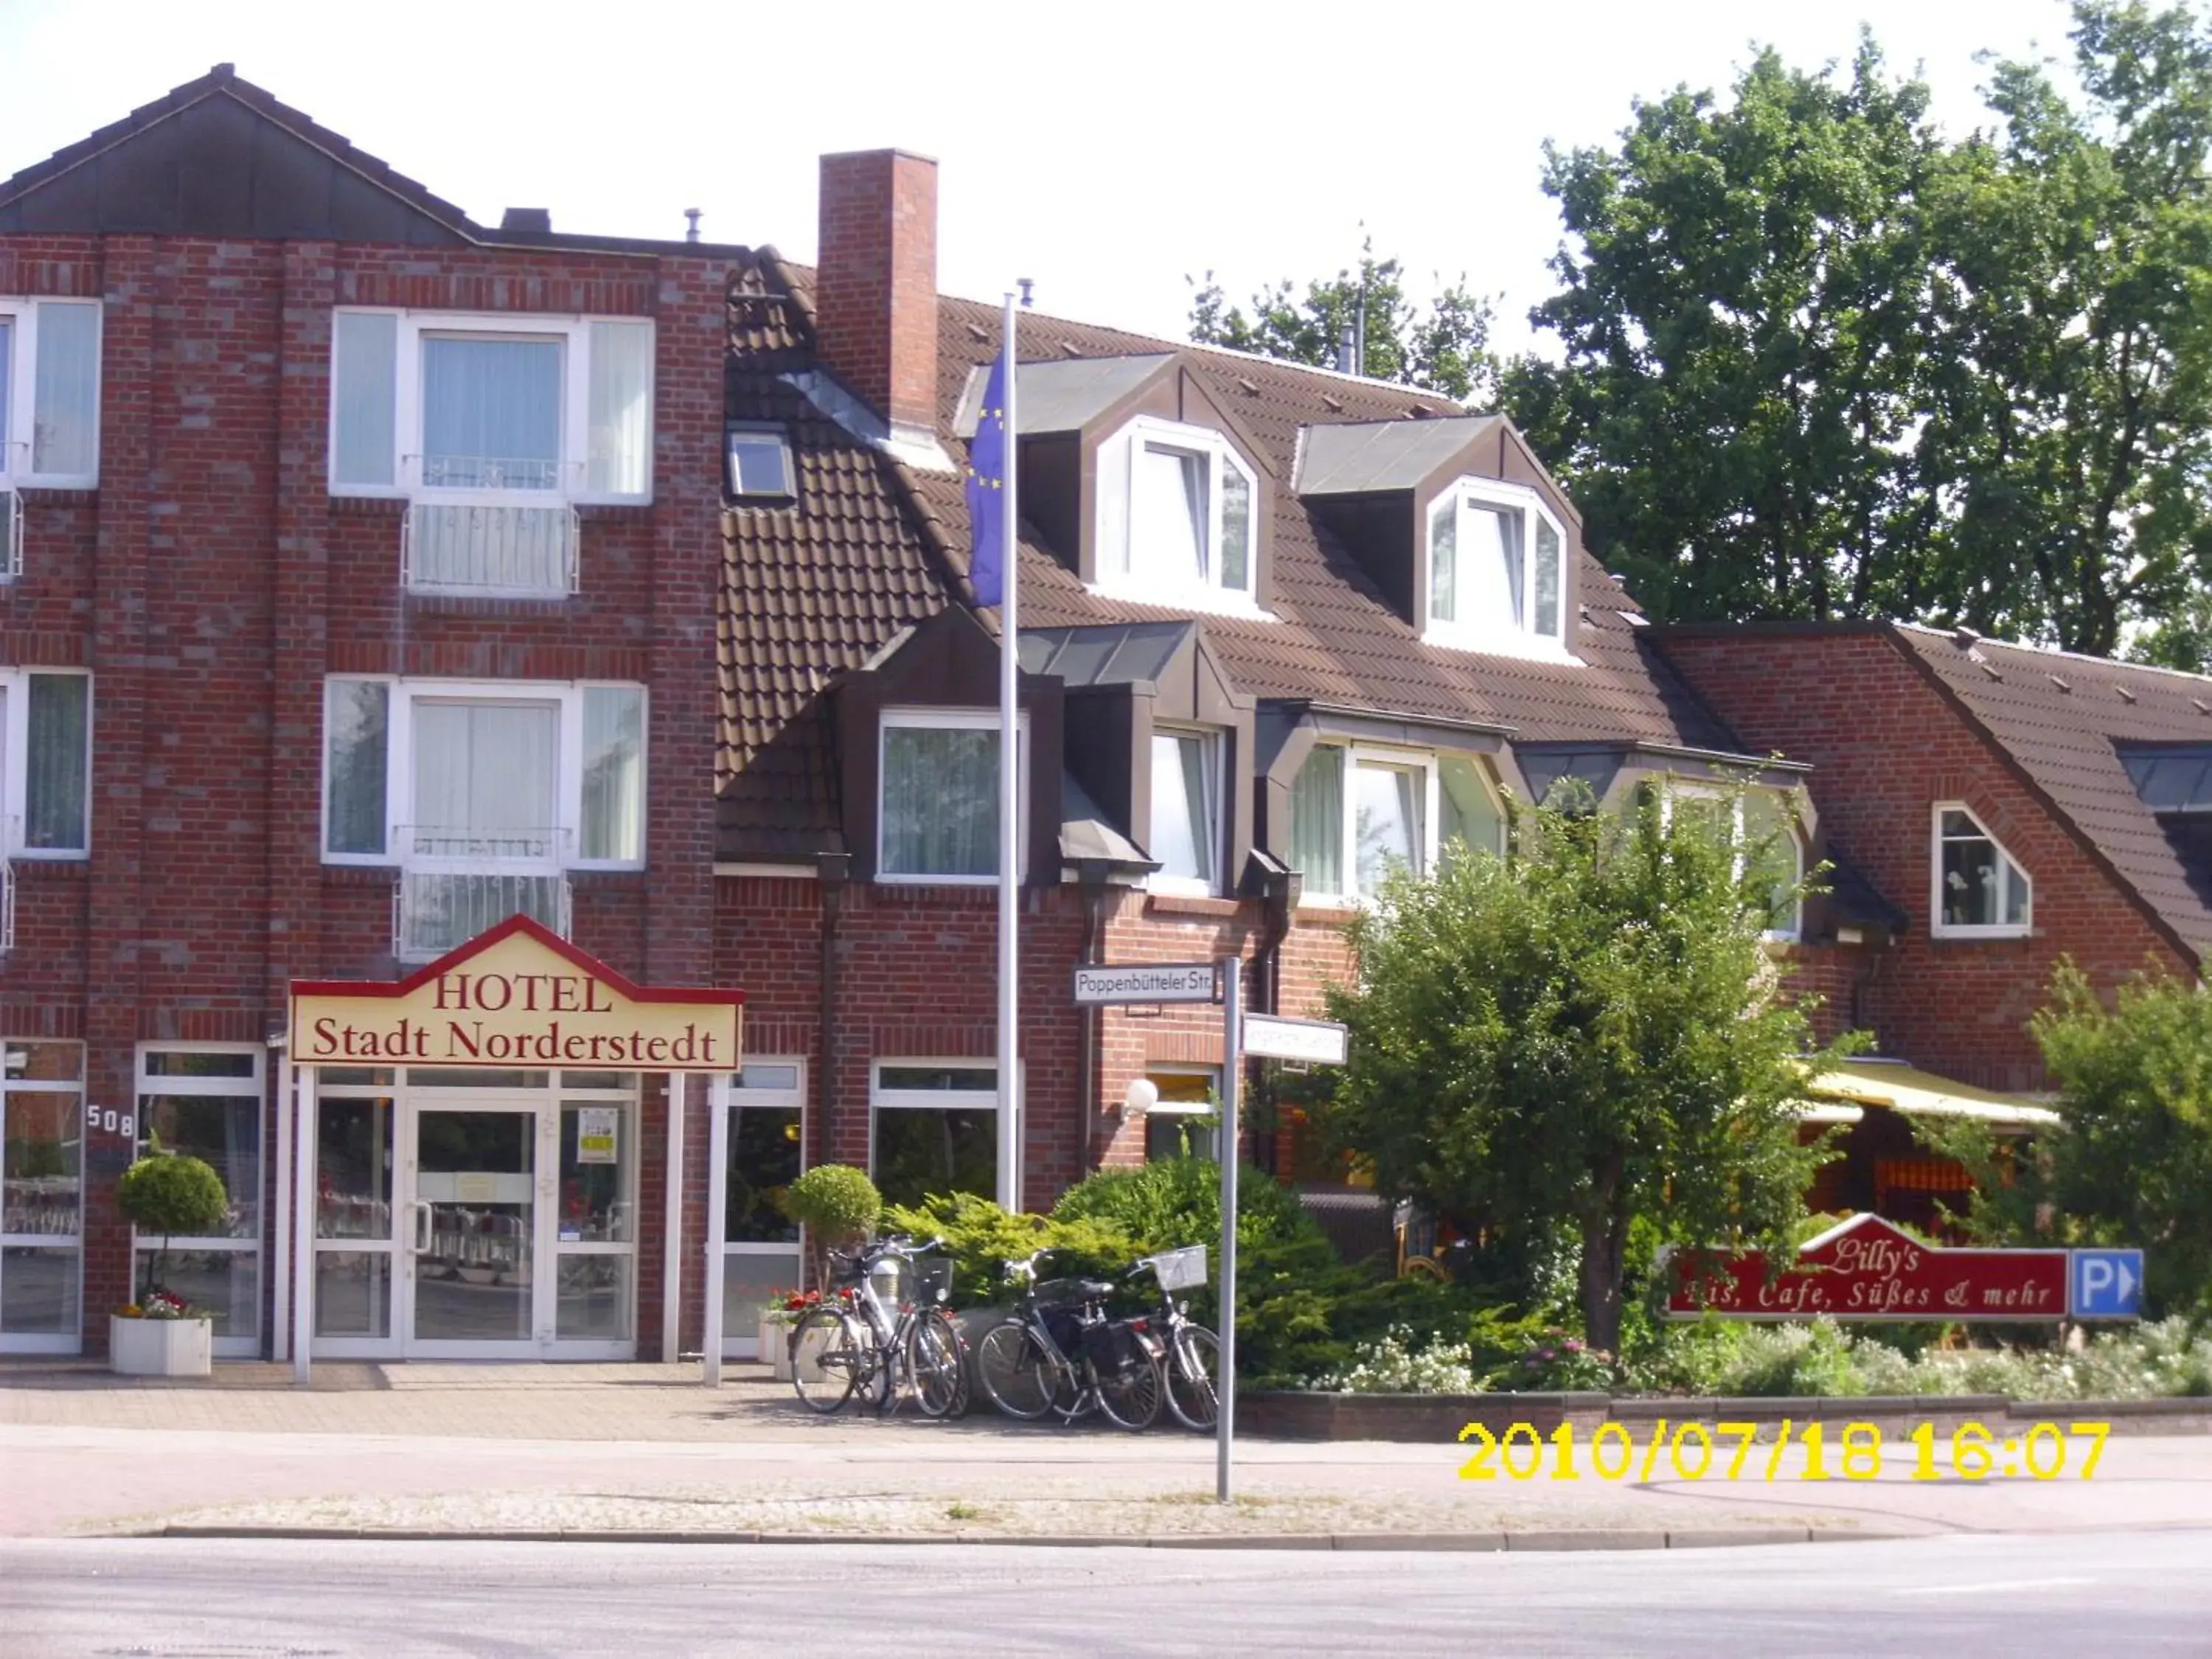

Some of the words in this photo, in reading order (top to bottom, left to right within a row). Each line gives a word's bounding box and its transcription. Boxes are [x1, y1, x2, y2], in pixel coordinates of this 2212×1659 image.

[433, 974, 613, 1012] HOTEL
[1078, 974, 1185, 995] Poppenbütteler
[1189, 971, 1211, 990] Str.
[313, 1018, 430, 1057] Stadt
[445, 1022, 717, 1062] Norderstedt
[87, 1105, 133, 1136] 508
[1823, 1237, 1919, 1281] Lilly's
[1846, 1279, 1930, 1312] Süßes
[1944, 1279, 1970, 1307] &
[1983, 1280, 2051, 1306] mehr
[2081, 1259, 2113, 1308] P
